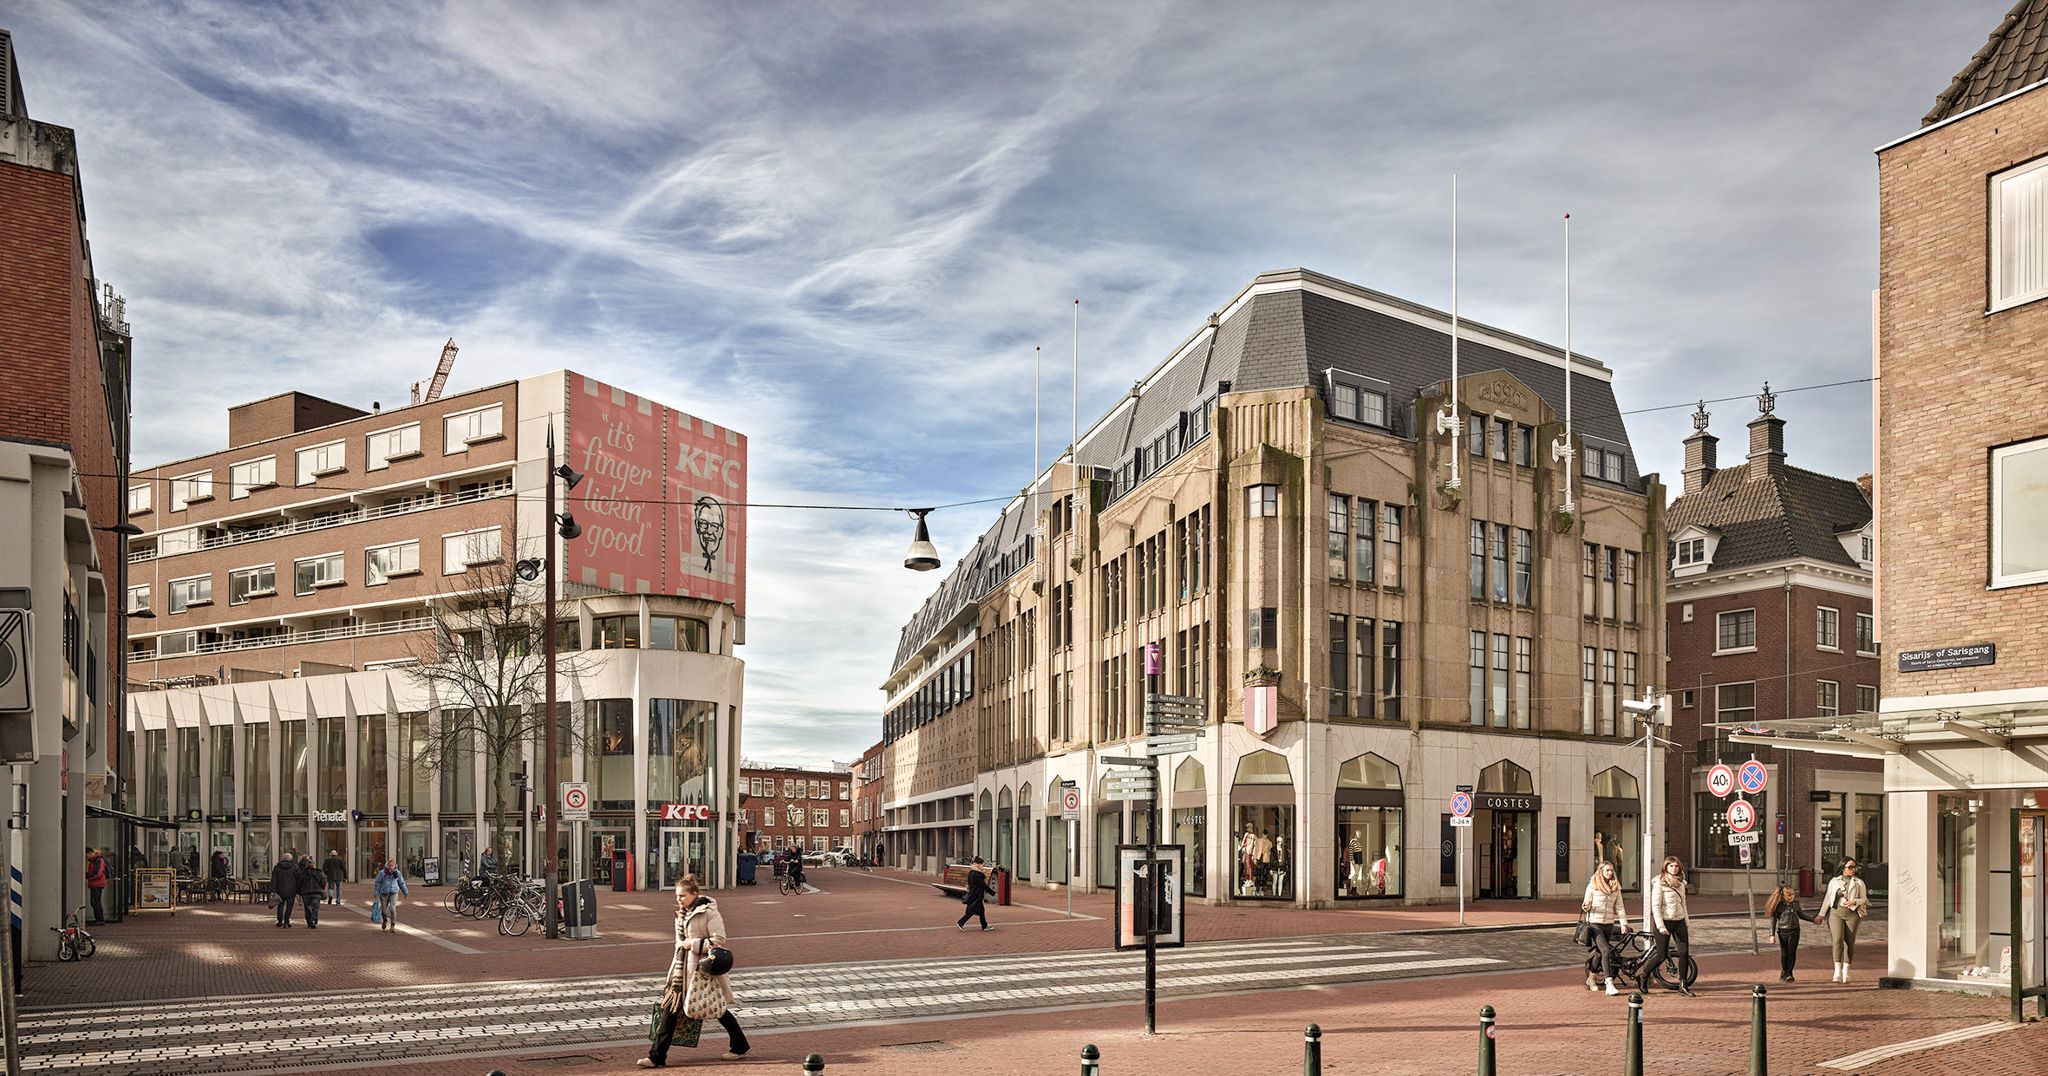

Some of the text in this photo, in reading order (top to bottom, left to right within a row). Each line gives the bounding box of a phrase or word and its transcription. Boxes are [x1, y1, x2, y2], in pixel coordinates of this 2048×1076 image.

[583, 436, 652, 493] finger
[675, 442, 741, 489] KFC
[584, 477, 645, 523] lickin'
[585, 521, 652, 558] good"
[1901, 651, 1934, 661] Sisarijs-
[1936, 649, 1945, 657] of
[1947, 646, 1990, 657] Sarisgang
[665, 804, 709, 820] KFC
[1487, 797, 1530, 809] COSTES
[1823, 845, 1839, 854] SALE
